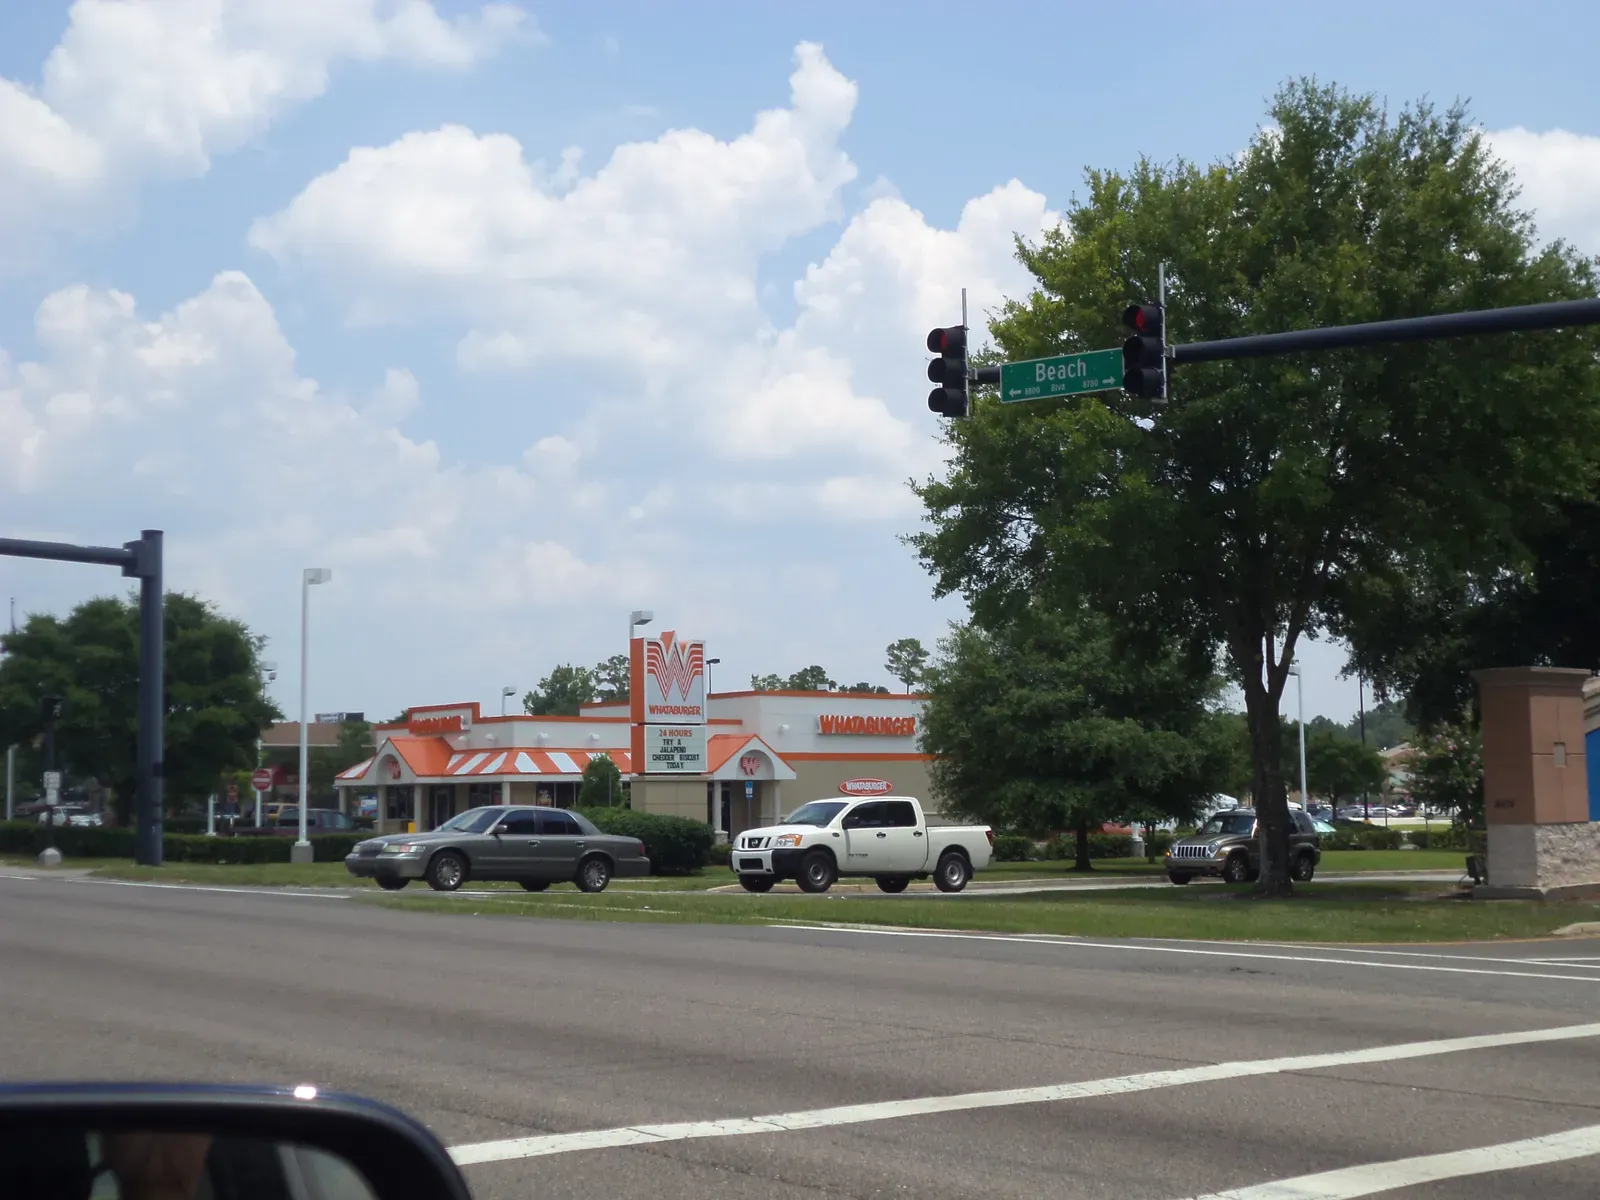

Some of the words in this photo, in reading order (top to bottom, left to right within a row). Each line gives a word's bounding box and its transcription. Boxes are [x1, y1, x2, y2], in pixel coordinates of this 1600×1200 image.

[1036, 359, 1087, 382] Beach
[1051, 384, 1066, 392] Blvd
[1082, 379, 1099, 389] 8700
[649, 705, 701, 716] WHATABURGER
[819, 715, 916, 735] WHATABURGER
[659, 729, 668, 737] 24
[669, 729, 692, 737] HOURS
[662, 738, 674, 746] TRY
[677, 738, 682, 746] A
[666, 761, 685, 769] TODAY
[846, 781, 888, 791] WHATABURGER
